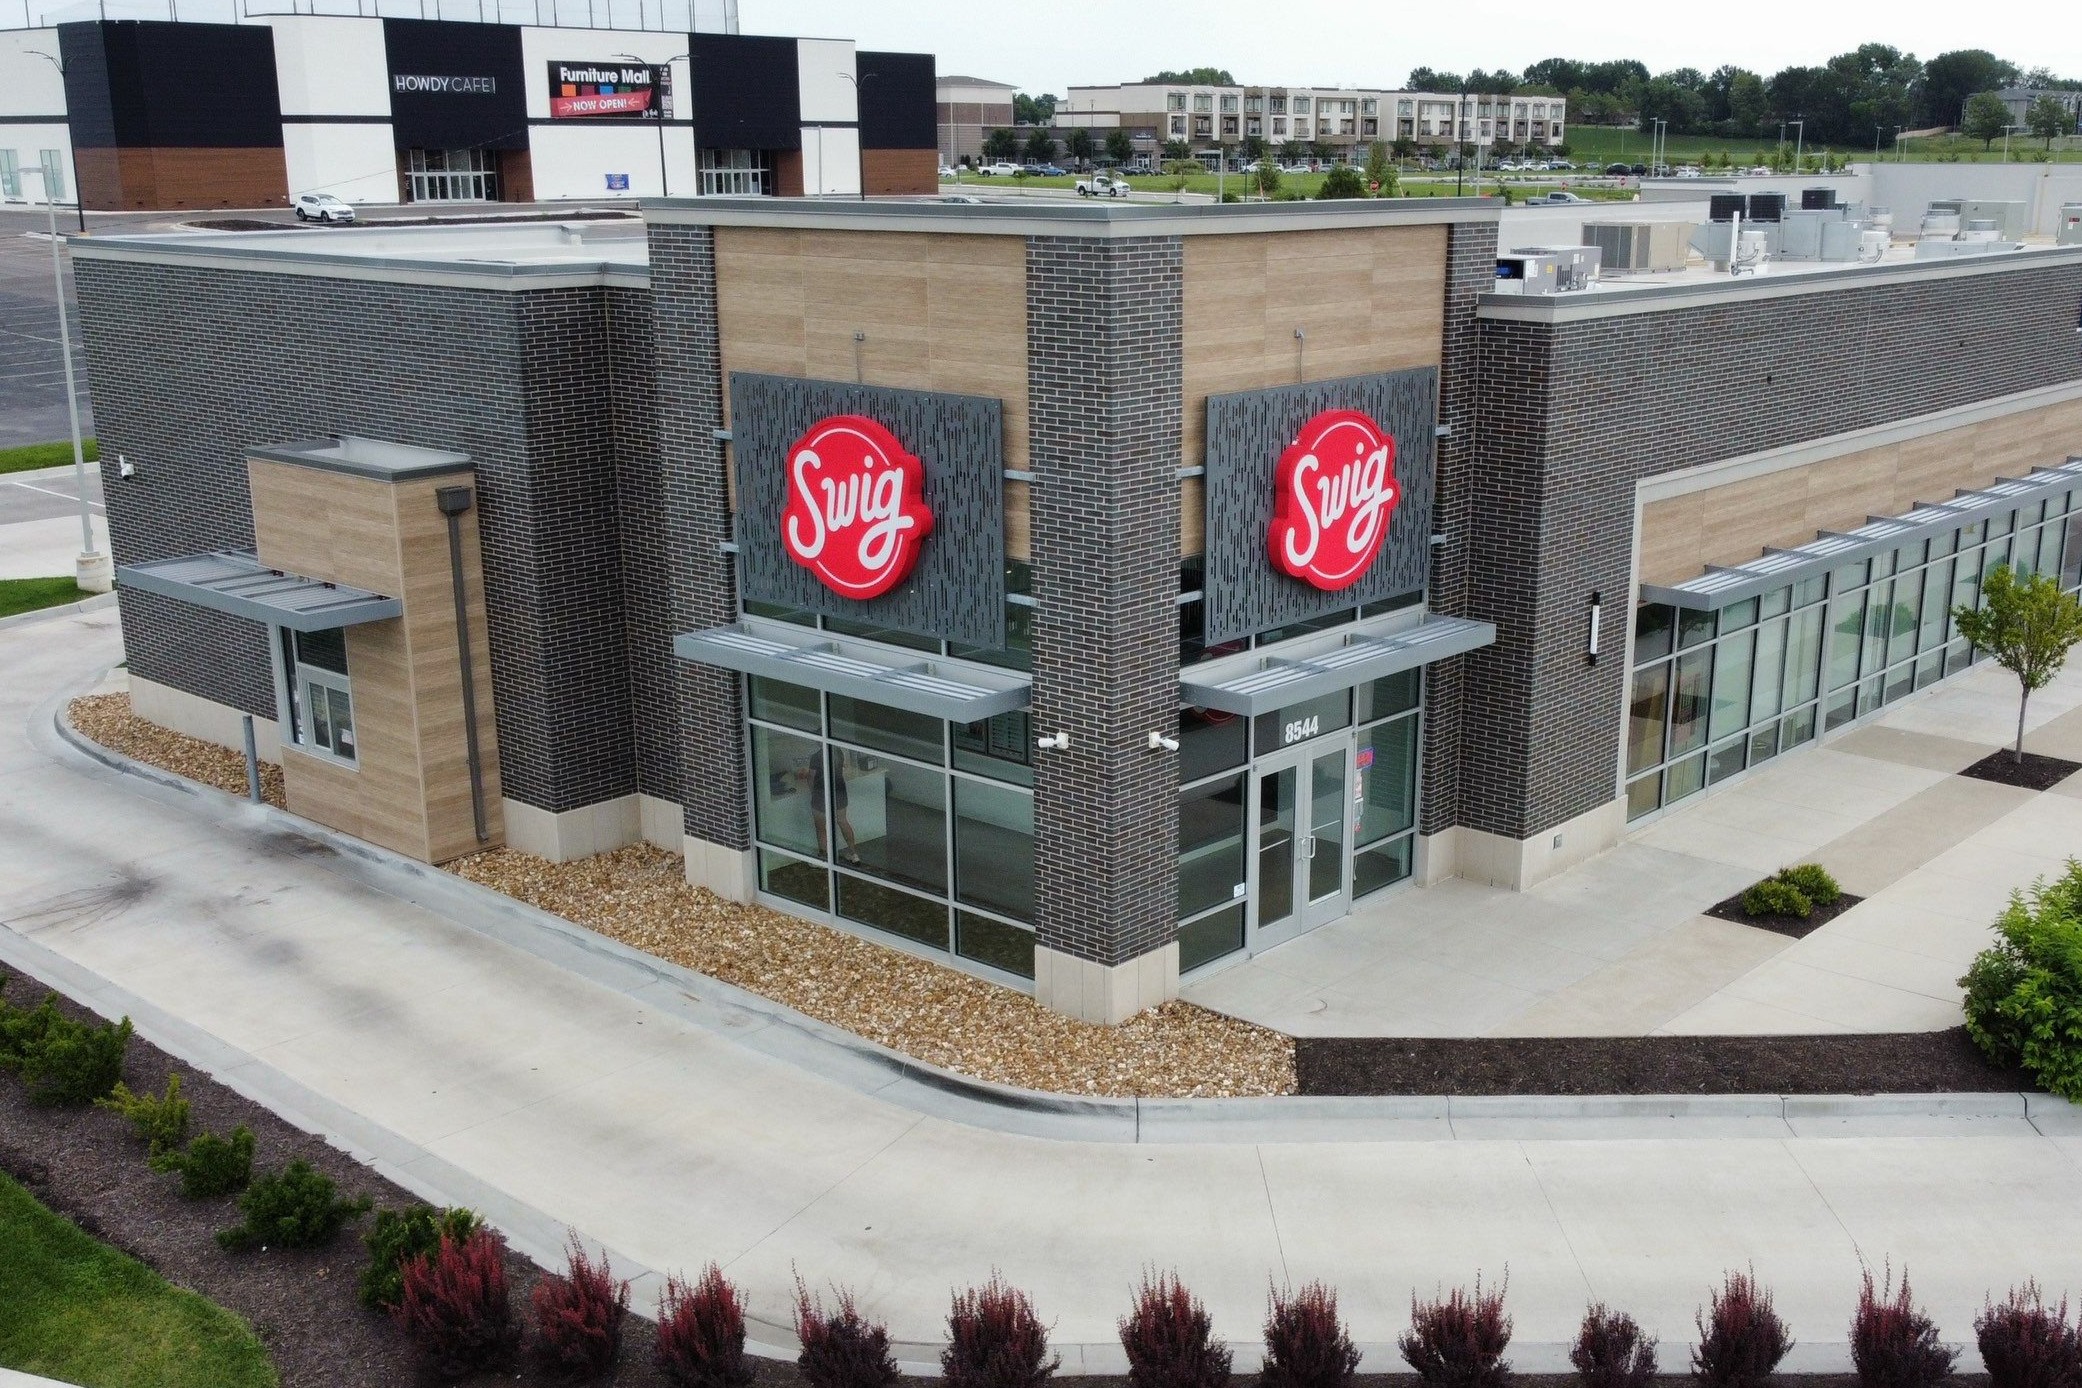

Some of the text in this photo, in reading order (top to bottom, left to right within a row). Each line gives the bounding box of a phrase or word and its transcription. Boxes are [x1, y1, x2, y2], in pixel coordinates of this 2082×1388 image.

[395, 75, 490, 92] HOWDY CAFE
[560, 66, 619, 83] Furniture
[621, 69, 651, 84] Mall
[573, 99, 627, 112] NOW OPEN!
[788, 449, 915, 570] Swig
[1285, 442, 1394, 567] Swig
[1284, 714, 1319, 744] 8544
